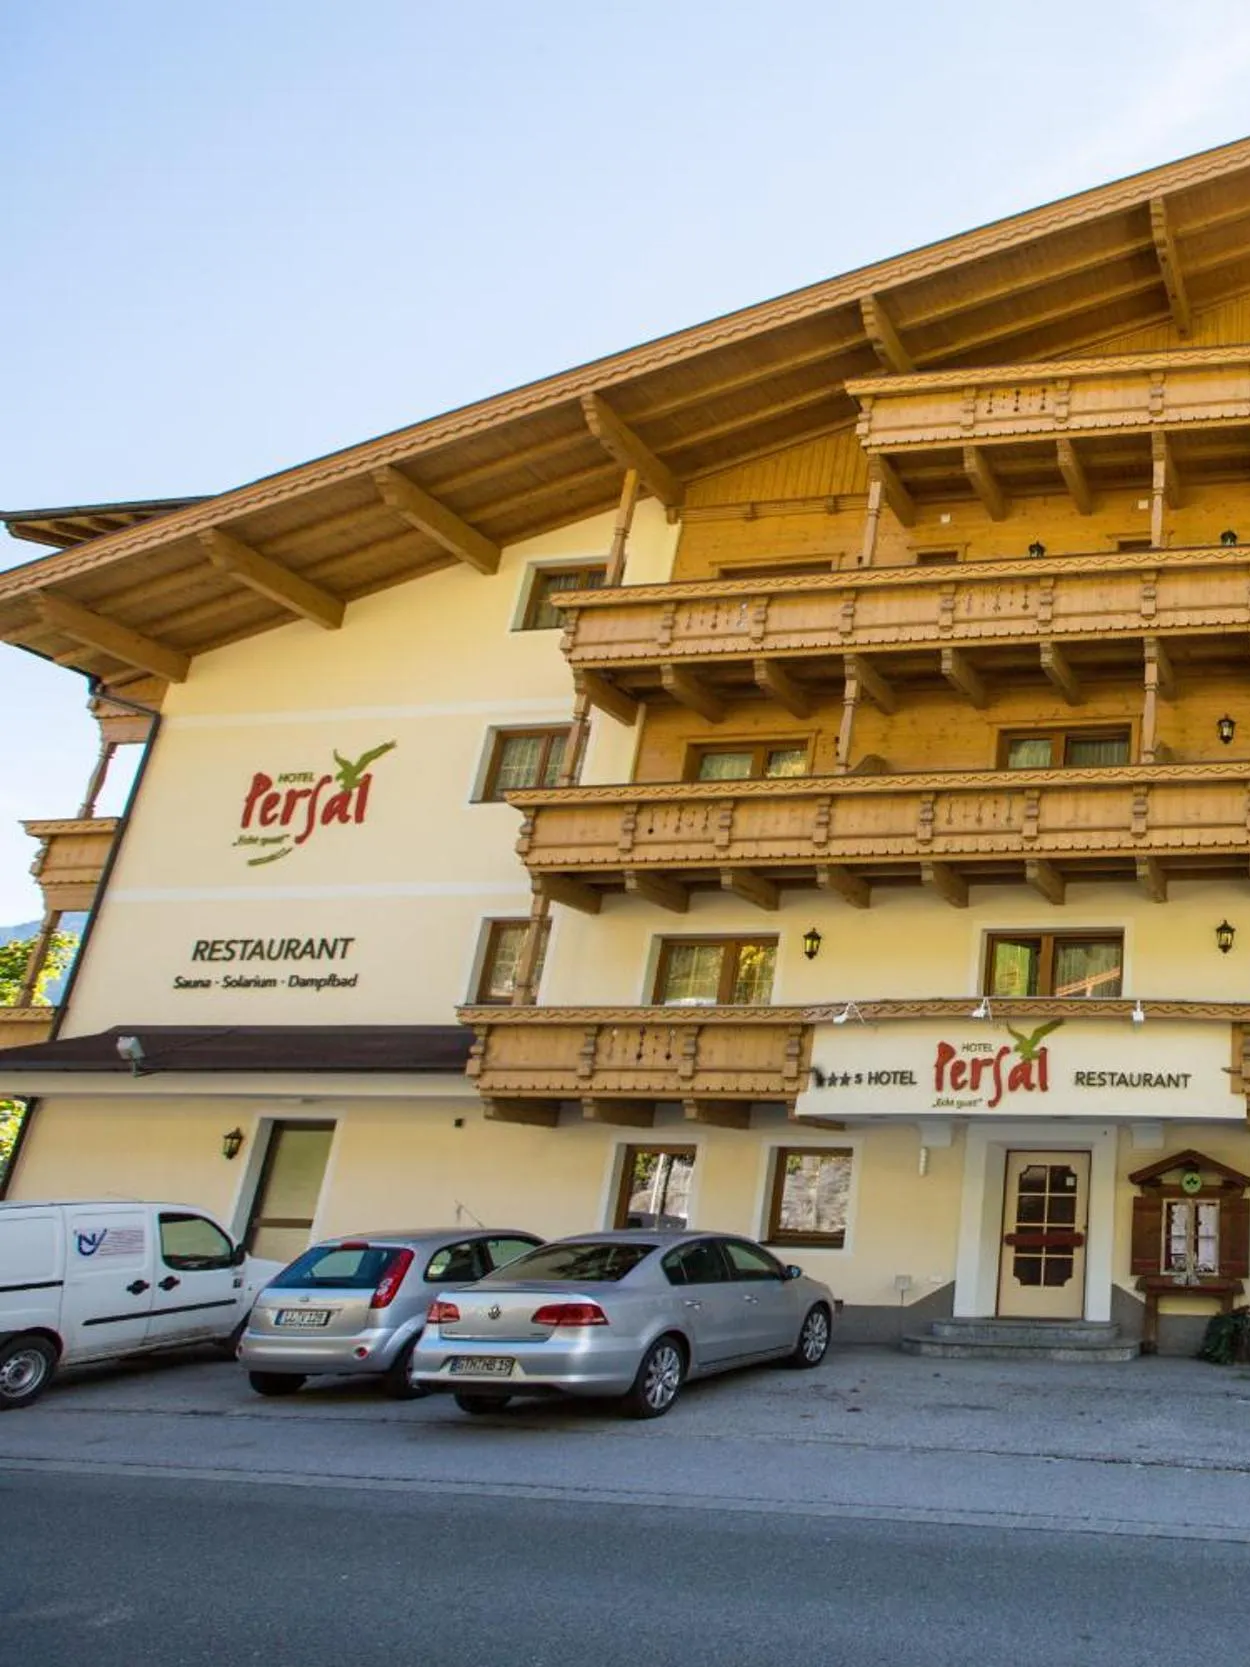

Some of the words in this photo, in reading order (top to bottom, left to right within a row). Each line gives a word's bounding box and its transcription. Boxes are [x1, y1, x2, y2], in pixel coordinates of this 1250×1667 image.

[191, 937, 355, 961] RESTAURANT
[173, 975, 212, 990] Sauna
[221, 974, 278, 990] Solarium
[287, 973, 359, 992] Dampfbad
[961, 1042, 994, 1053] HOTEL
[867, 1070, 918, 1086] HOTEL
[1074, 1070, 1193, 1089] RESTAURANT
